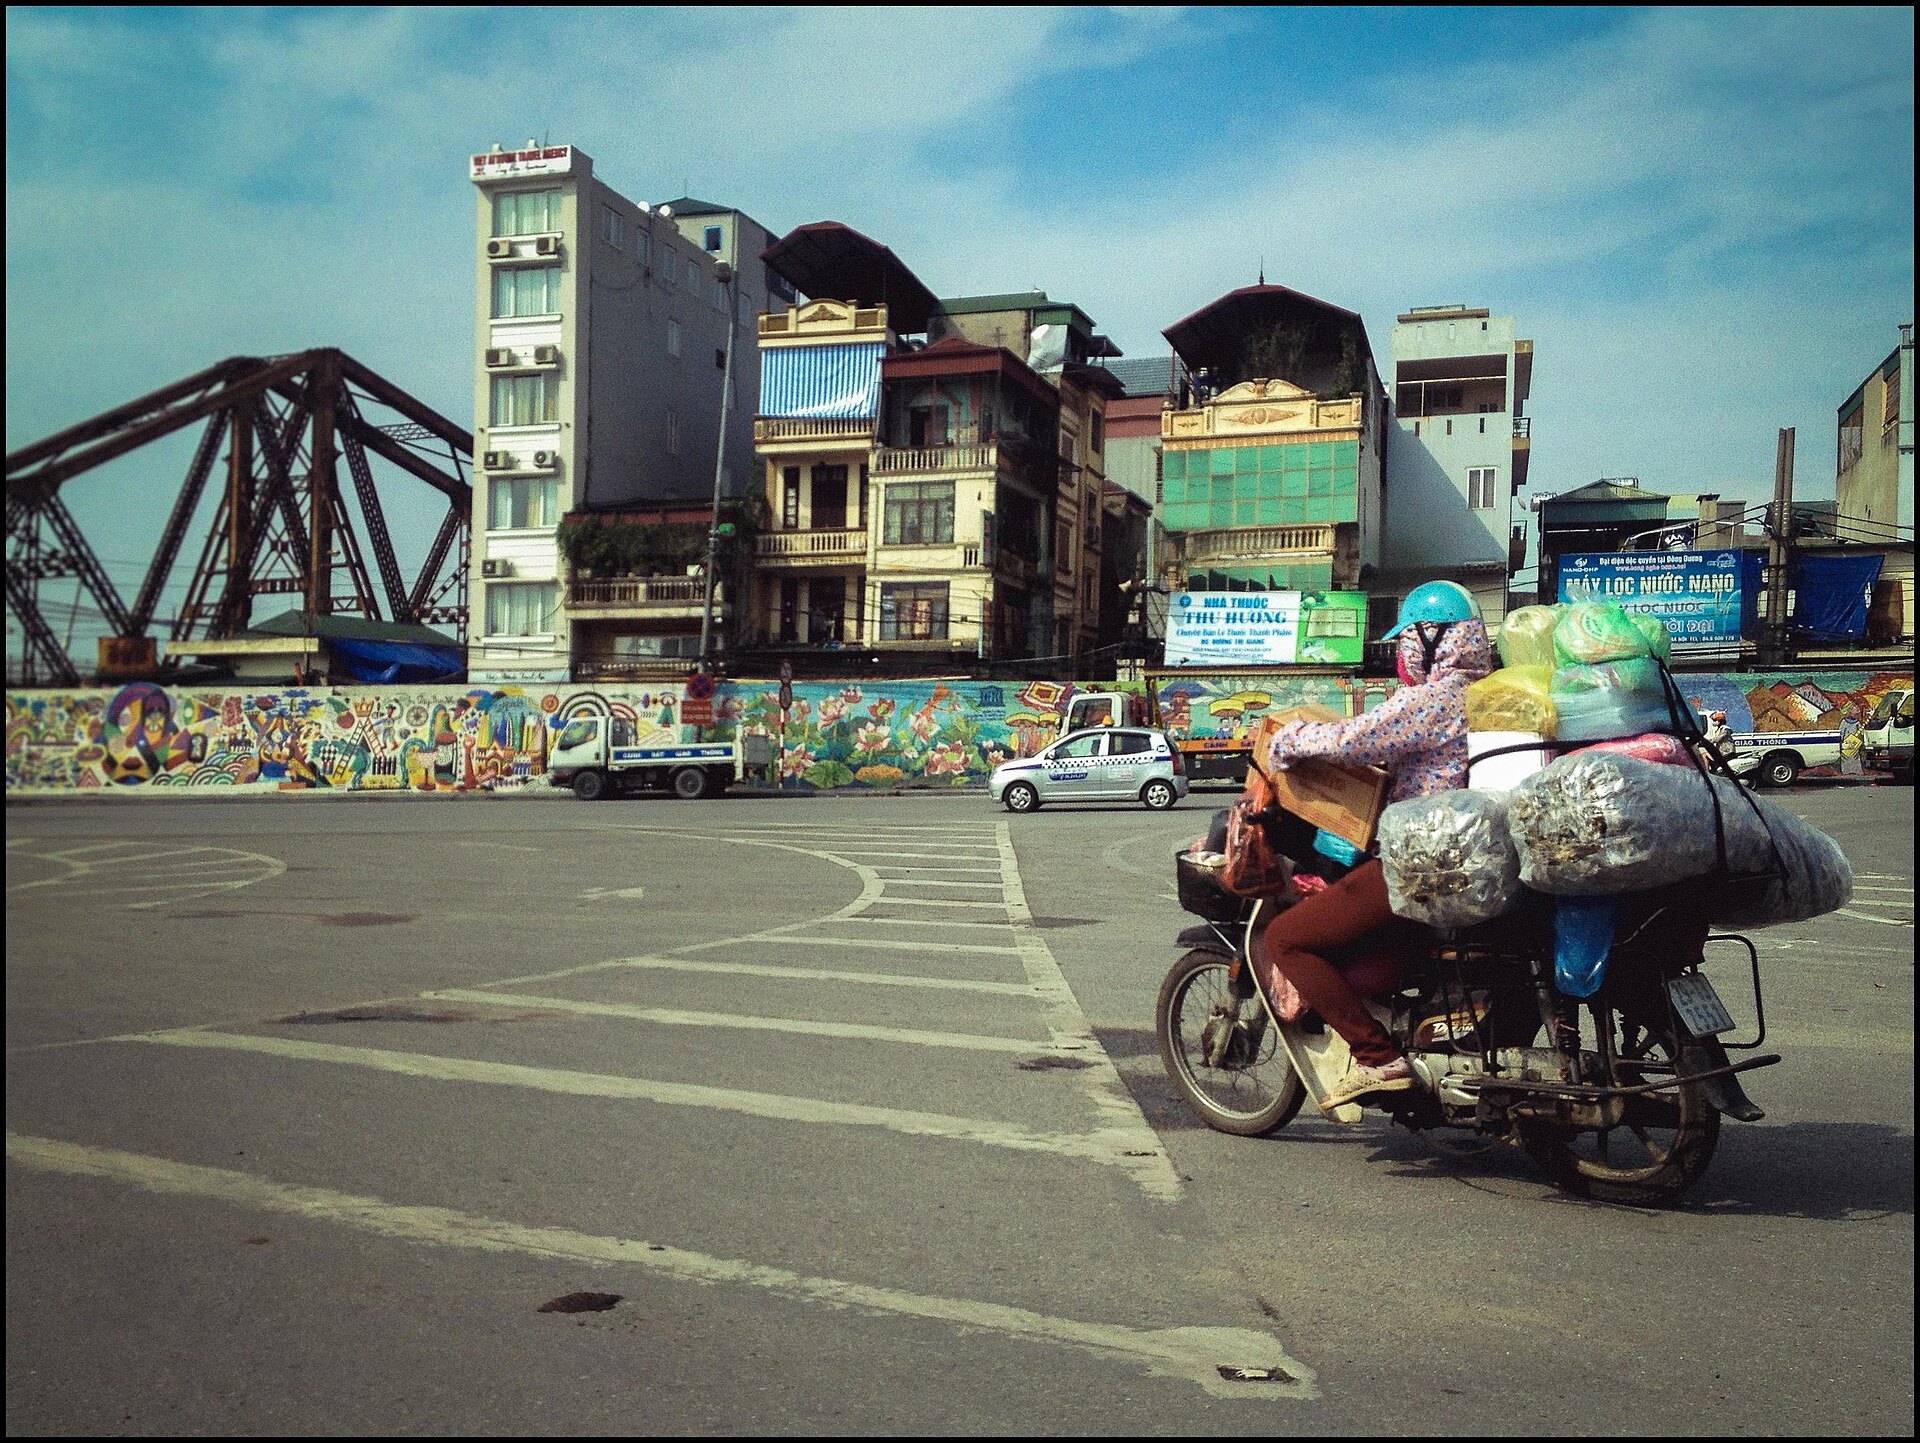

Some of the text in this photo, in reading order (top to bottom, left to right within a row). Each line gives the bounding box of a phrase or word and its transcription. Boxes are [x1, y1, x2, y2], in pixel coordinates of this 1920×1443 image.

[1605, 576, 1635, 600] LỌC
[1639, 571, 1684, 595] NƯỚC
[1688, 574, 1735, 593] NANO
